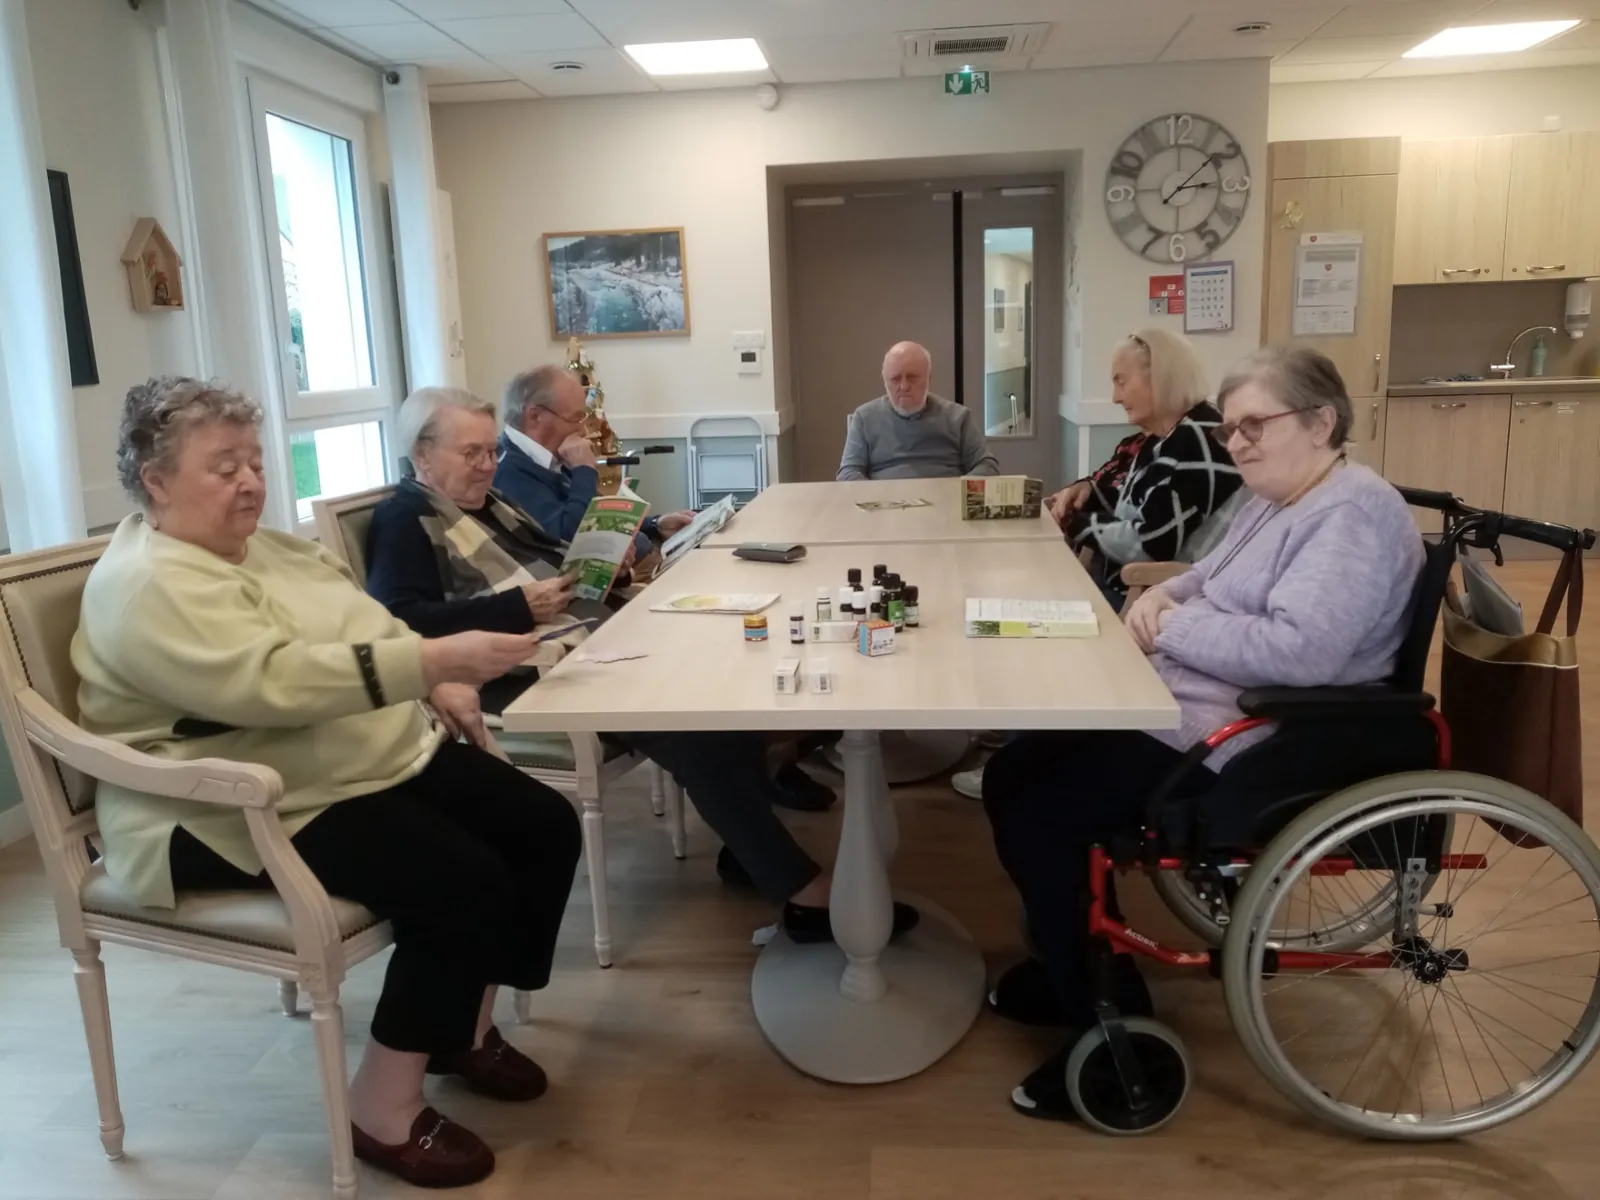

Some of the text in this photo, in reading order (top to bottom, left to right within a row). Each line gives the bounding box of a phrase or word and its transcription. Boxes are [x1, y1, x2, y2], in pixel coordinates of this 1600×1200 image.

[1166, 115, 1194, 146] 12
[1110, 151, 1144, 179] 10
[1210, 142, 1241, 169] 2
[1107, 185, 1135, 202] 9
[1222, 175, 1250, 192] 3
[1169, 233, 1186, 261] 6
[1195, 220, 1220, 250] 5
